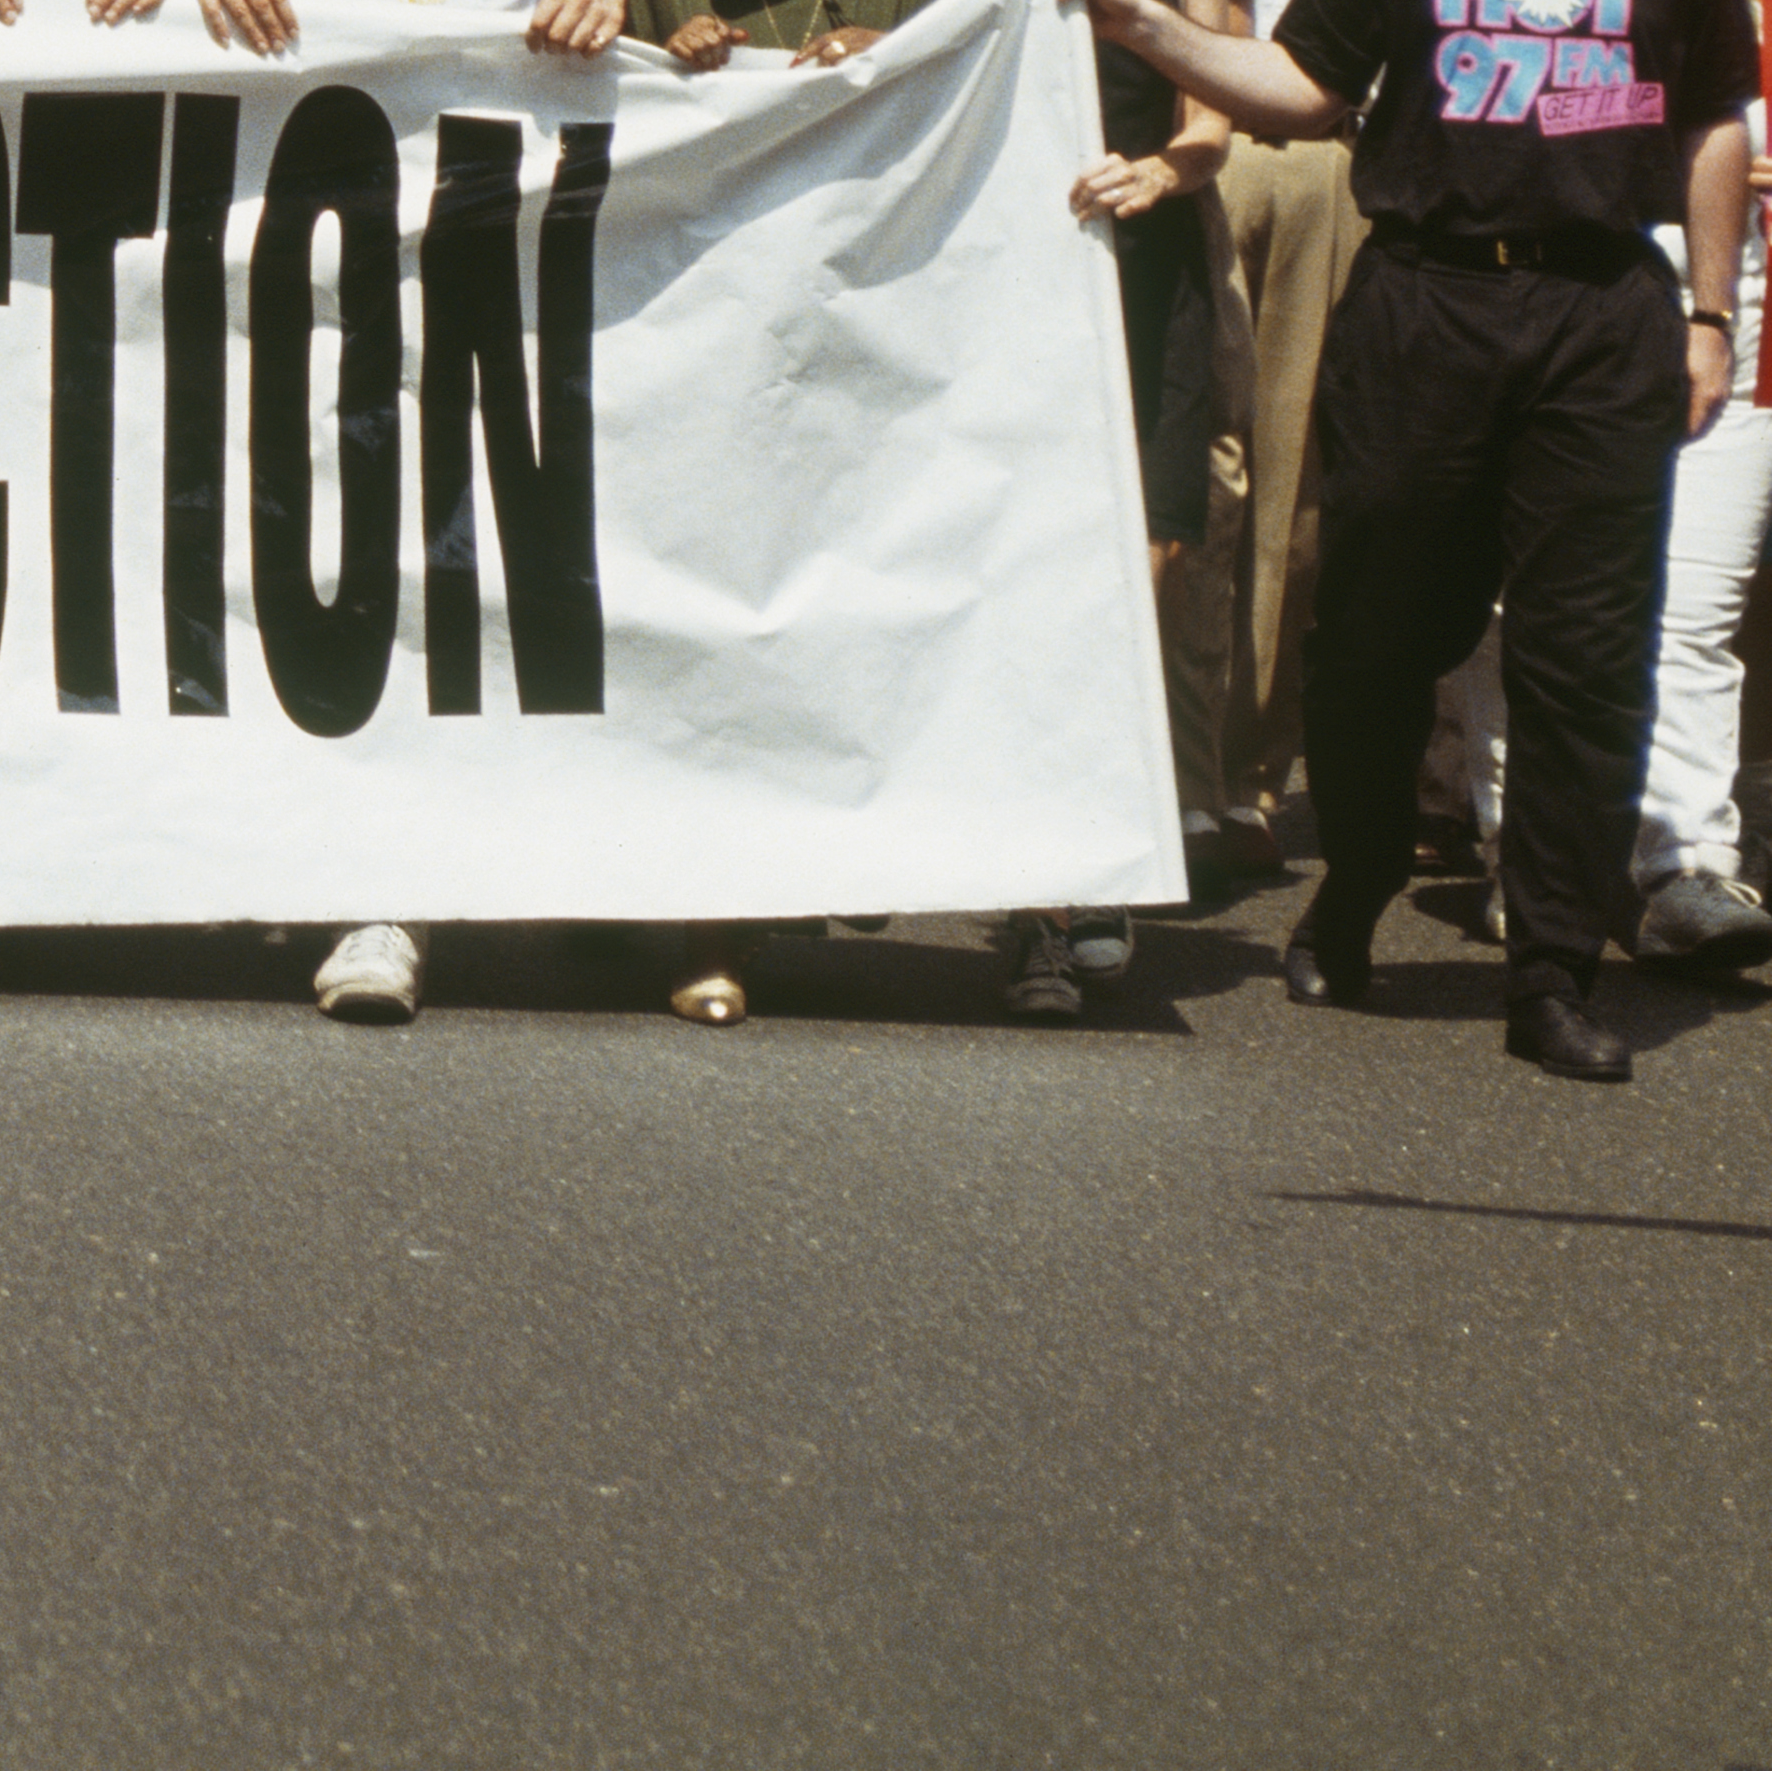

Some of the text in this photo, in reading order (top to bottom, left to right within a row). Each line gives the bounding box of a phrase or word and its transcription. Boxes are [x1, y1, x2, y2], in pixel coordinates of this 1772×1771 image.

[1434, 29, 1635, 124] 97 FM
[1543, 91, 1594, 122] GET
[1595, 87, 1622, 115] IT
[1625, 84, 1660, 111] UP
